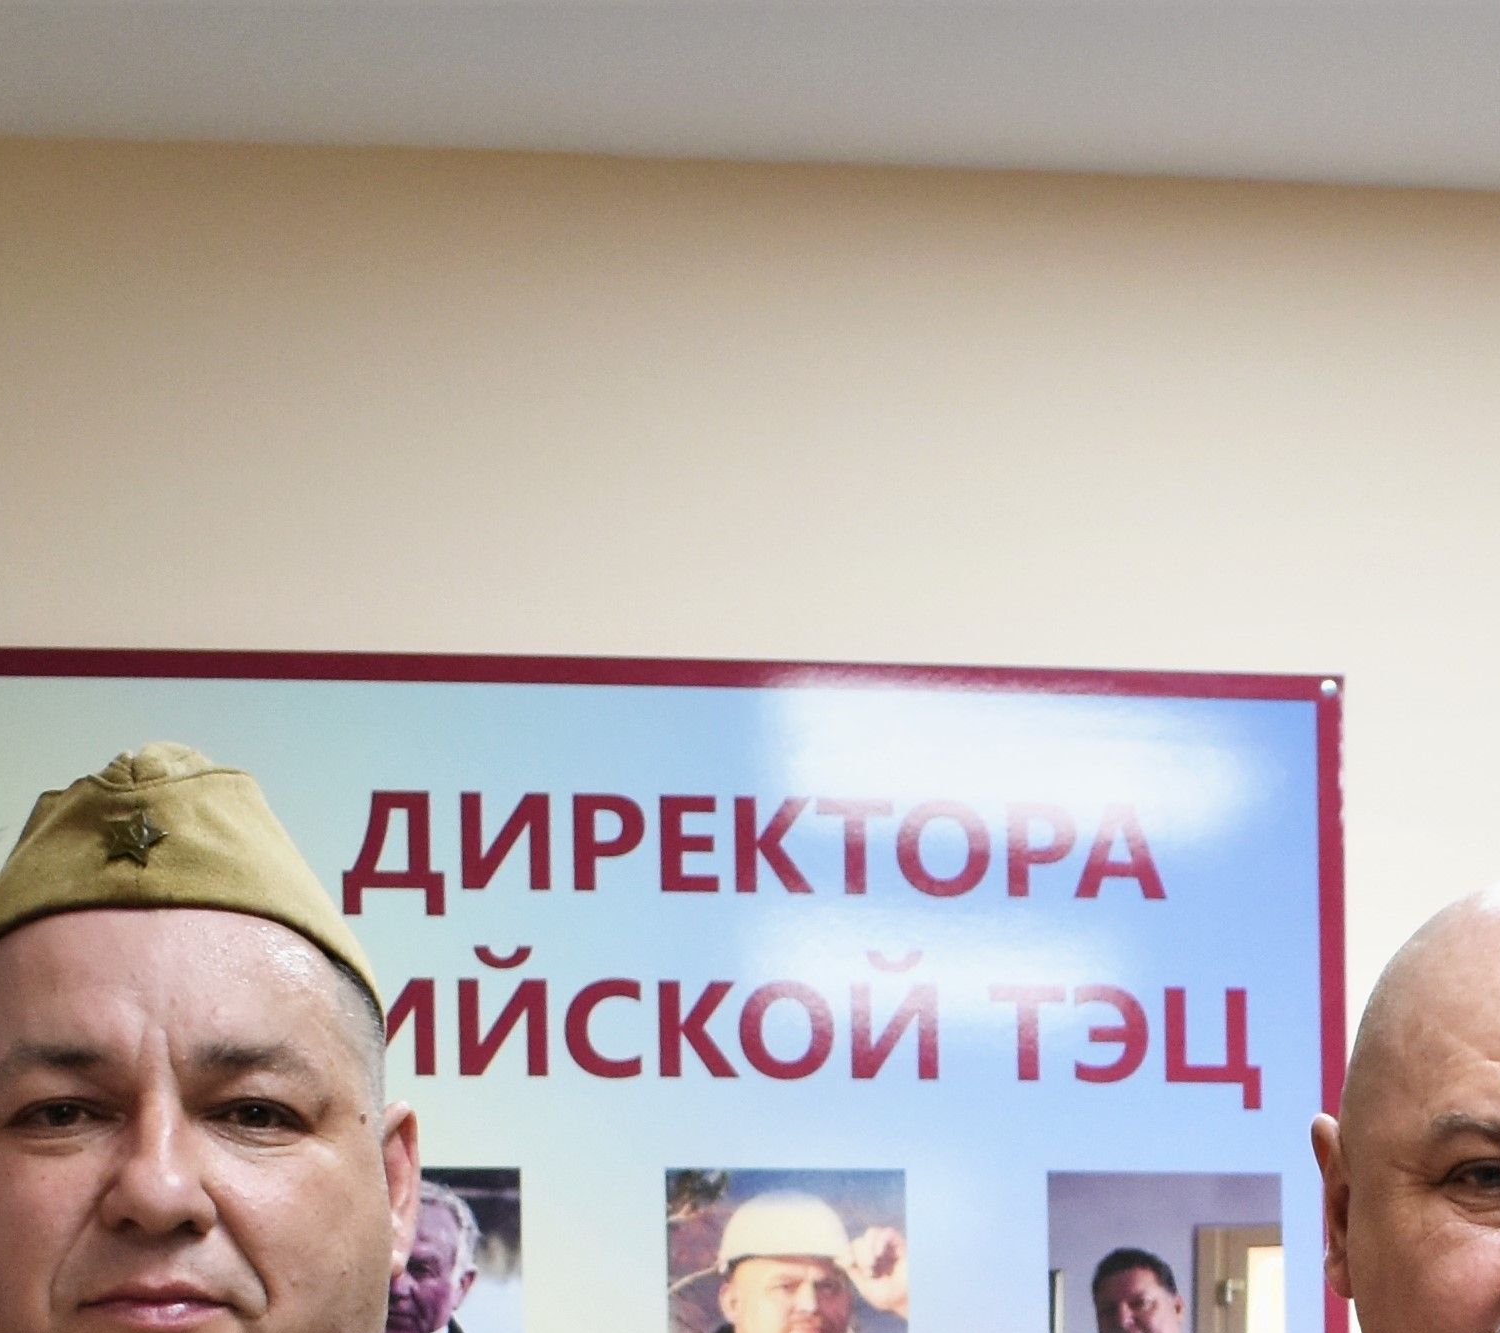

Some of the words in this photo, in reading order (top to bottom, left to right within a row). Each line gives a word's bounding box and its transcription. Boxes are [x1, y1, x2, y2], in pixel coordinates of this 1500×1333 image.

[341, 789, 1167, 916] ДИРЕКТОРА
[385, 944, 940, 1079] ИЙСКОЙ
[988, 984, 1263, 1110] ТЭЦ
